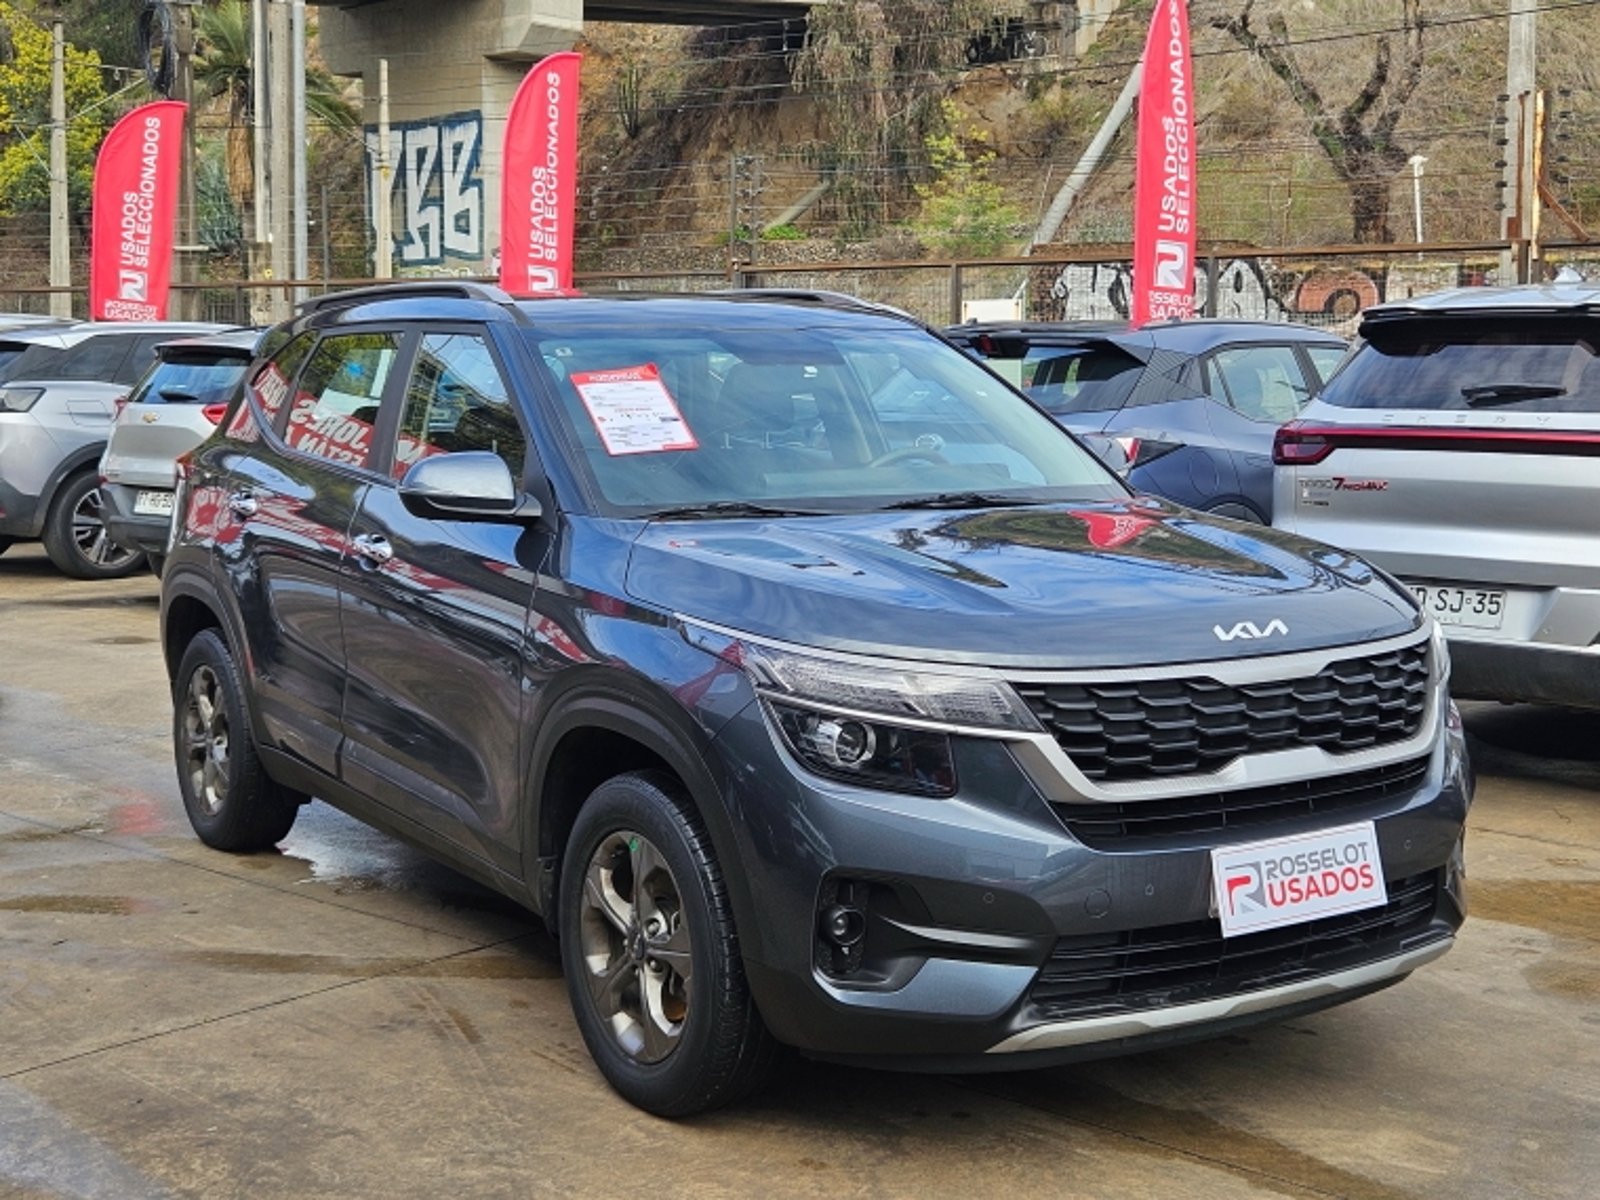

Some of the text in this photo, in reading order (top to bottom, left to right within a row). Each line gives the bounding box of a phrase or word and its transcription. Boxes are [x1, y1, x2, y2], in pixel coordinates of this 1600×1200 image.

[1168, 0, 1191, 235] SELECCIONADOS
[134, 116, 161, 268] SELECCIONADOS
[528, 166, 547, 259] USADOS
[545, 71, 561, 262] SELECCIONADOS
[1157, 115, 1178, 232] USADOS
[120, 191, 139, 265] USADOS
[1213, 619, 1289, 641] KIA
[1265, 841, 1368, 881] ROSSELOT
[1268, 864, 1374, 906] USADOS
